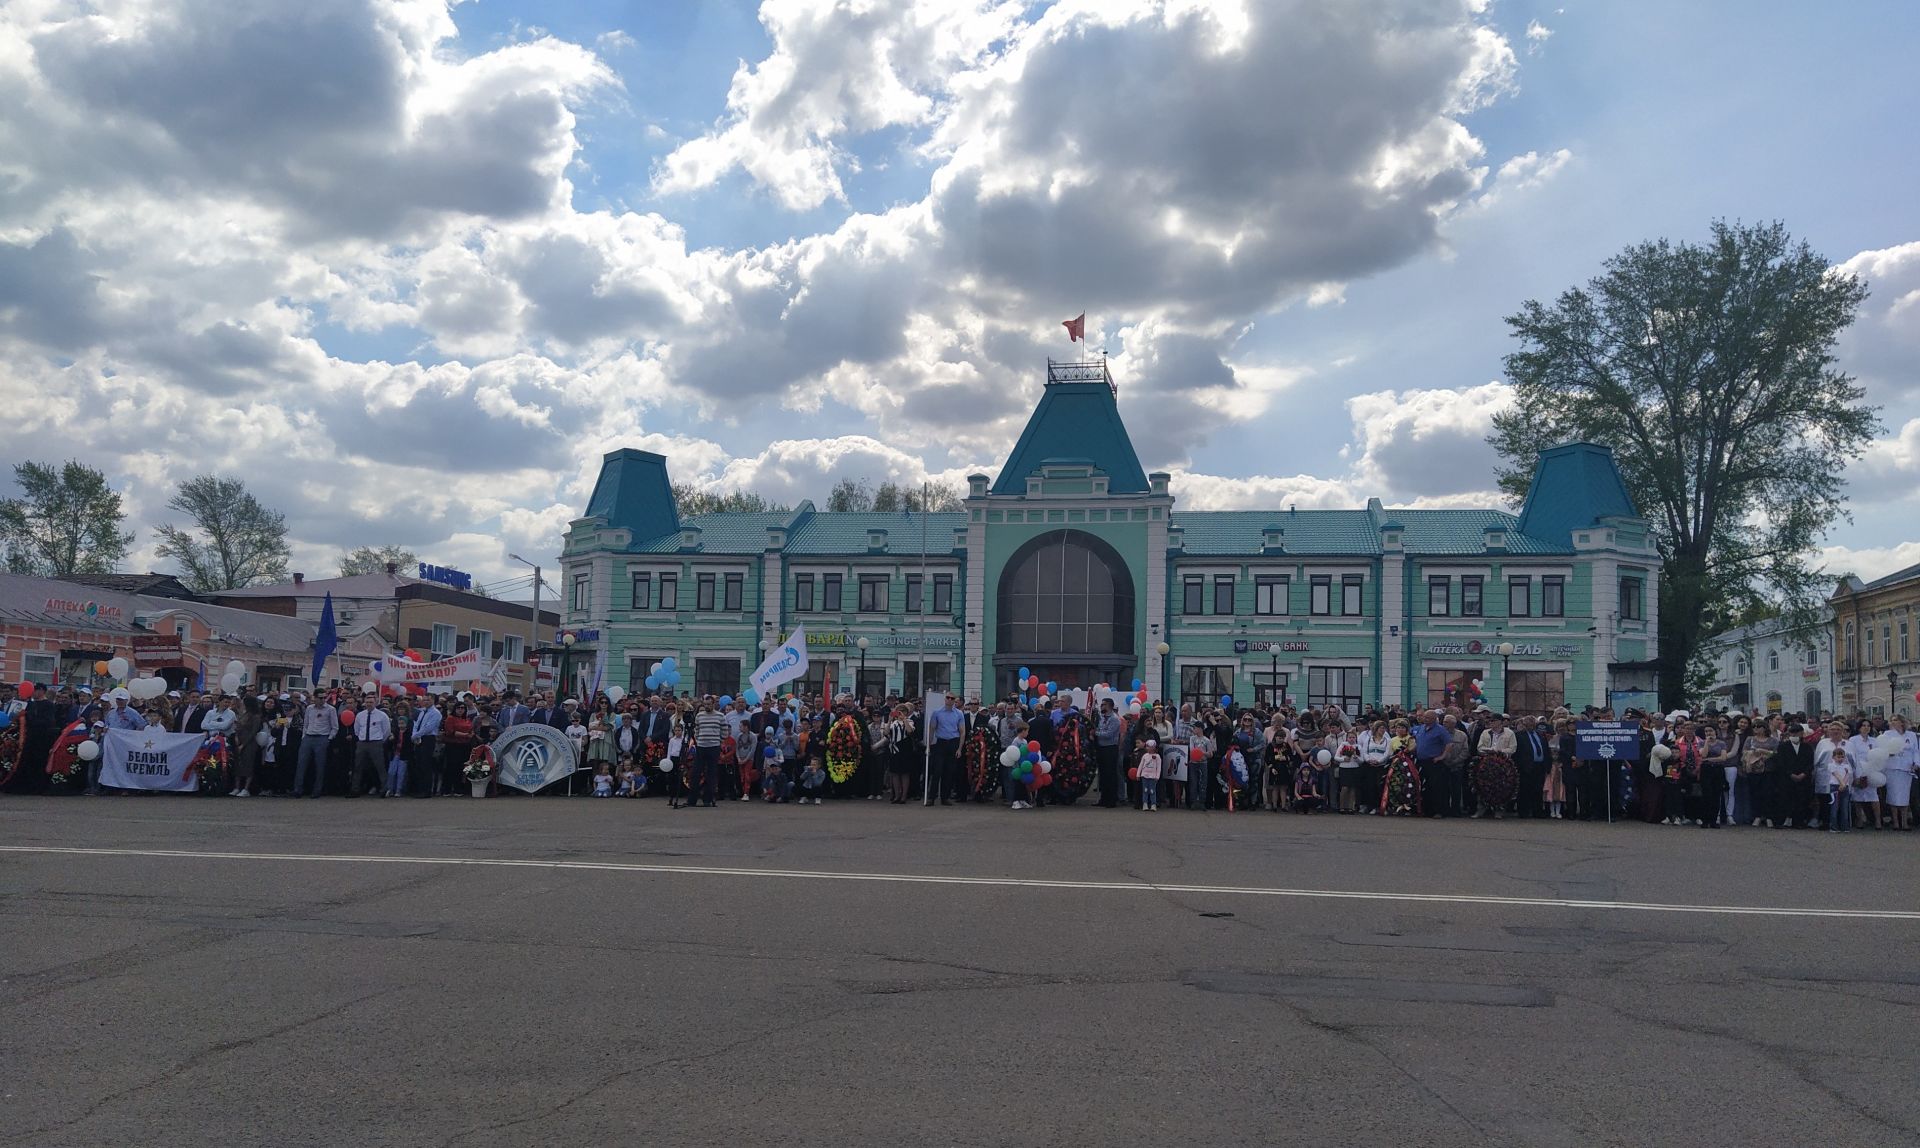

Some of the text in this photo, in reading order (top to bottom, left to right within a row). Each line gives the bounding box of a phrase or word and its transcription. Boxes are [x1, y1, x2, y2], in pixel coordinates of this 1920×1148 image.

[418, 562, 472, 590] SAMSUNG
[45, 599, 86, 613] АПТЕКА
[98, 604, 121, 616] ВИТА
[777, 632, 845, 646] ЛБАРД
[876, 636, 917, 646] LOUNGE
[1283, 641, 1309, 651] БАНК
[1427, 646, 1465, 654] АПТЕКА
[1482, 642, 1543, 655] АПЕЛЬ
[387, 653, 477, 670] ЧИСТОПОЛЬСКИЙ
[405, 666, 458, 681] АВТОДОР
[127, 750, 168, 764] БЕЛЫЙ
[126, 762, 170, 776] КРЕМЛЬ
